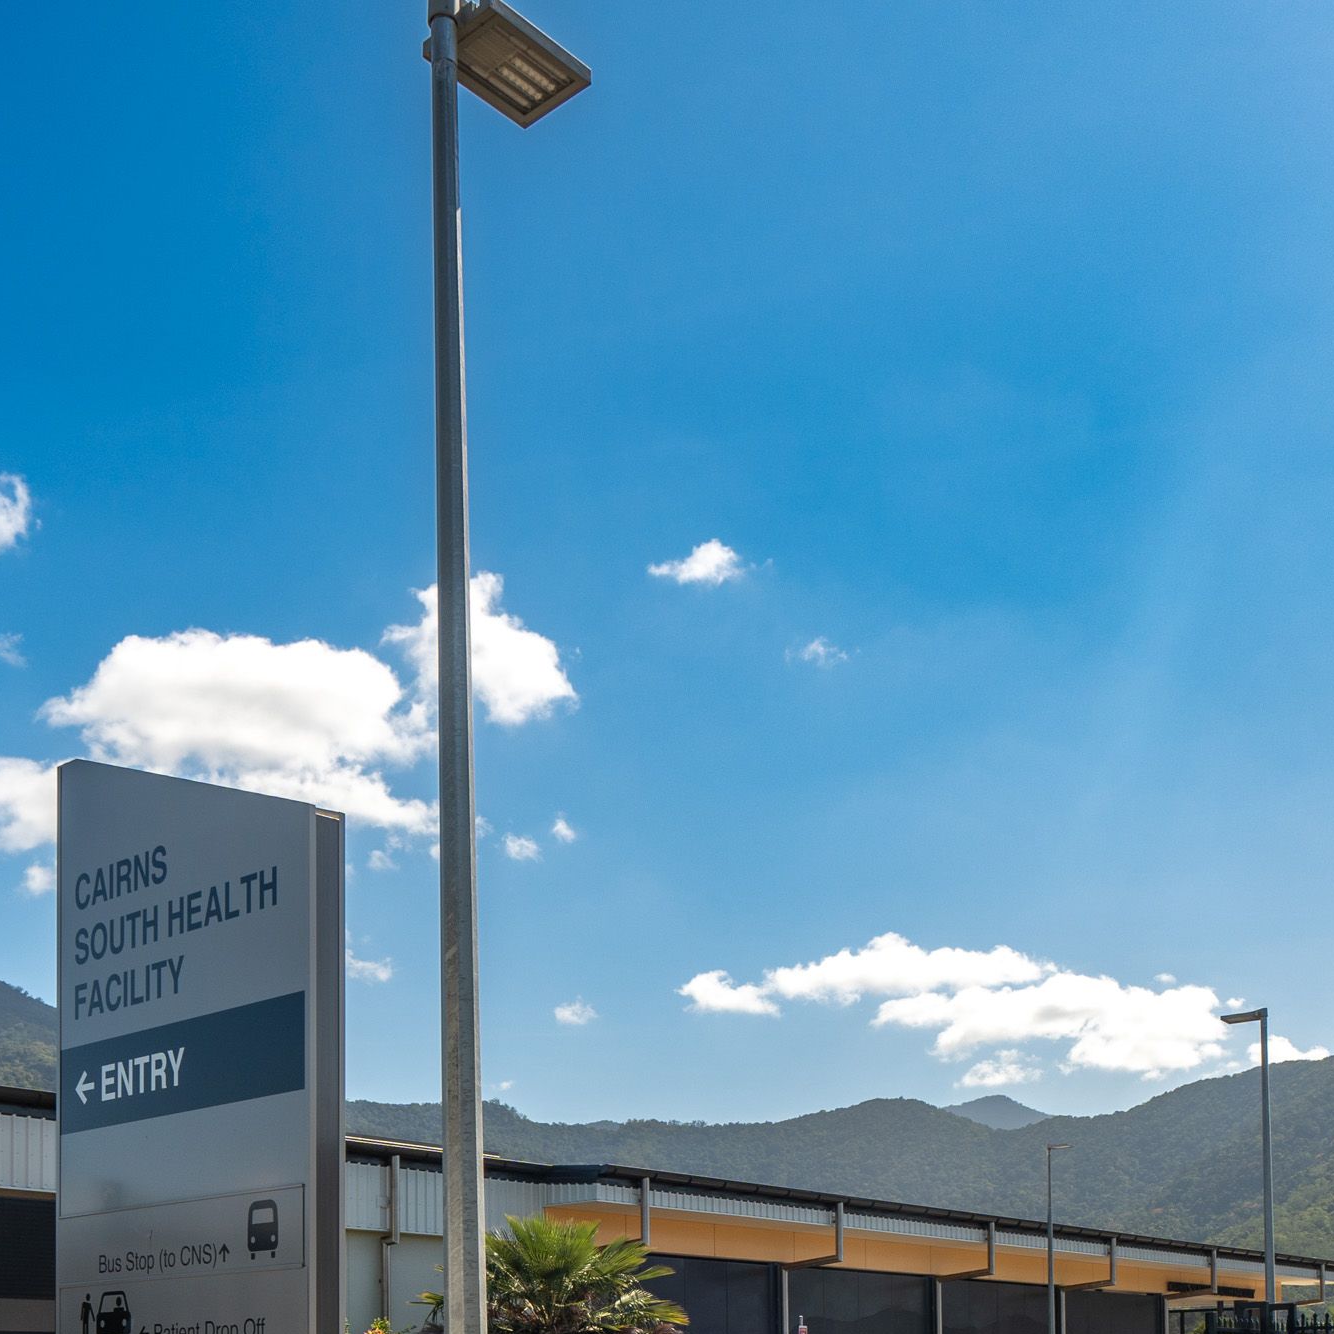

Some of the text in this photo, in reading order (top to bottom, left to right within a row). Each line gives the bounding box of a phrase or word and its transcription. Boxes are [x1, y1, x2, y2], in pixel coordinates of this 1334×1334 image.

[75, 845, 167, 910] CAIRNS
[75, 866, 278, 965] SOUTH HEALTH
[75, 955, 184, 1020] FACILITY
[101, 1047, 185, 1101] ENTRY
[98, 1243, 217, 1274] Bus Stop (to CNS)
